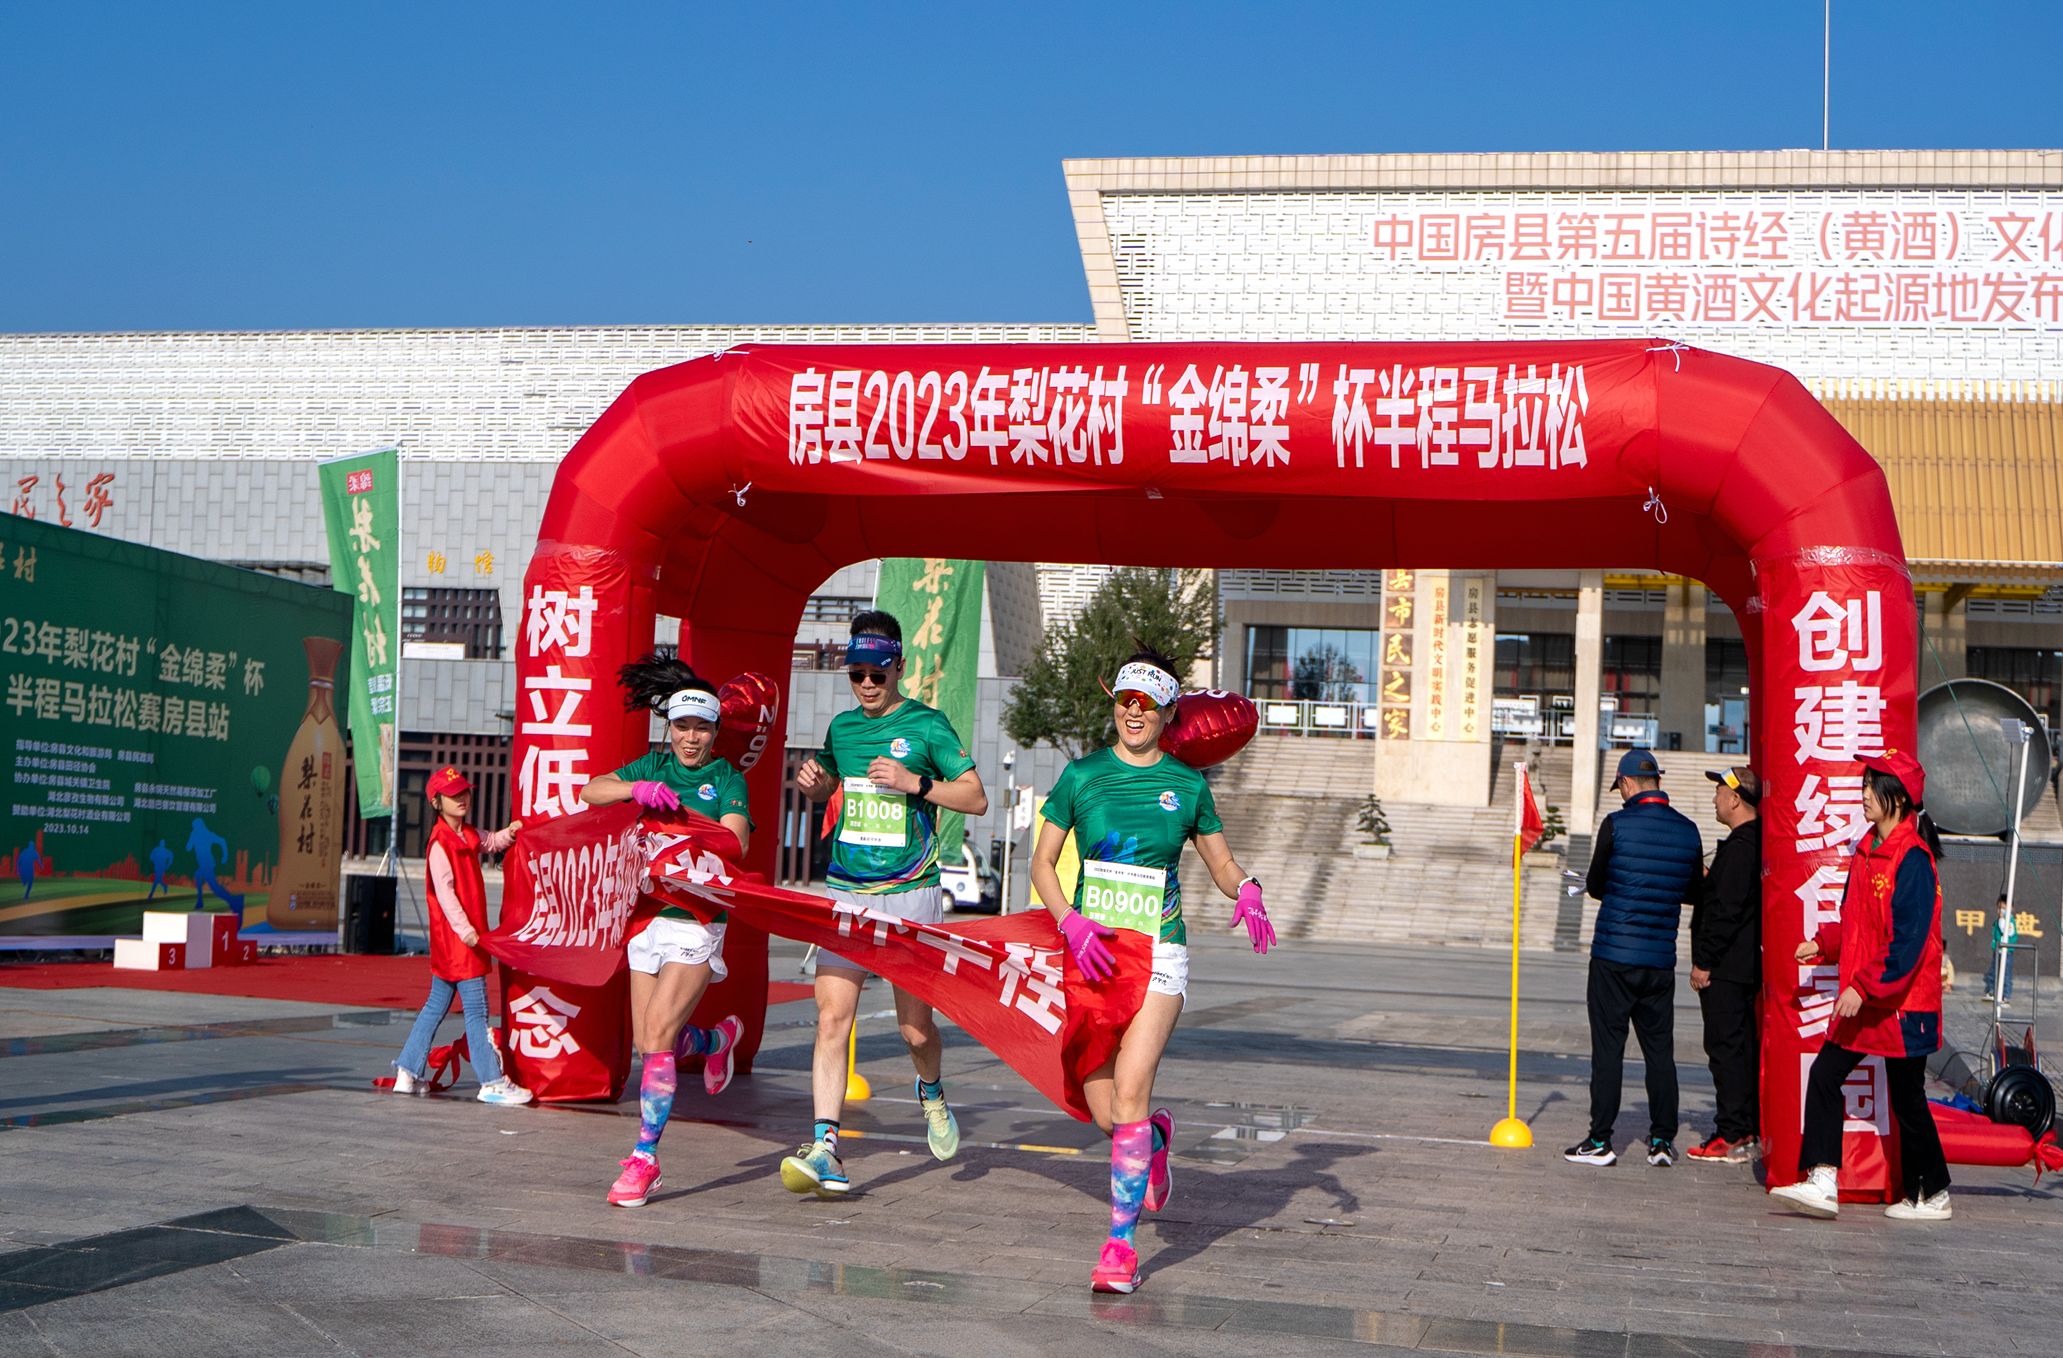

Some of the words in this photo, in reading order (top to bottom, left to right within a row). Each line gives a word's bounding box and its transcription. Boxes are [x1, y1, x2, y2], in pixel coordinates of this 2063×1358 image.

[1503, 271, 2063, 322] 暨中国黄酒文化起源地发布
[788, 363, 1590, 471] 房县2023年梨花村“金绵柔”杯半程马拉松
[0, 617, 266, 697] 23年梨花村“金绵柔”杯
[1430, 586, 1446, 733] 房县新时代文明实践中心
[1463, 586, 1481, 734] 房县志愿服务促进中心
[6, 673, 231, 742] 半程马拉松赛房县站
[43, 822, 89, 835] 2023.10.14
[847, 798, 903, 821] B1008
[1085, 885, 1159, 918] B0900
[168, 947, 176, 965] 3
[222, 931, 229, 951] 1
[243, 945, 250, 961] 2
